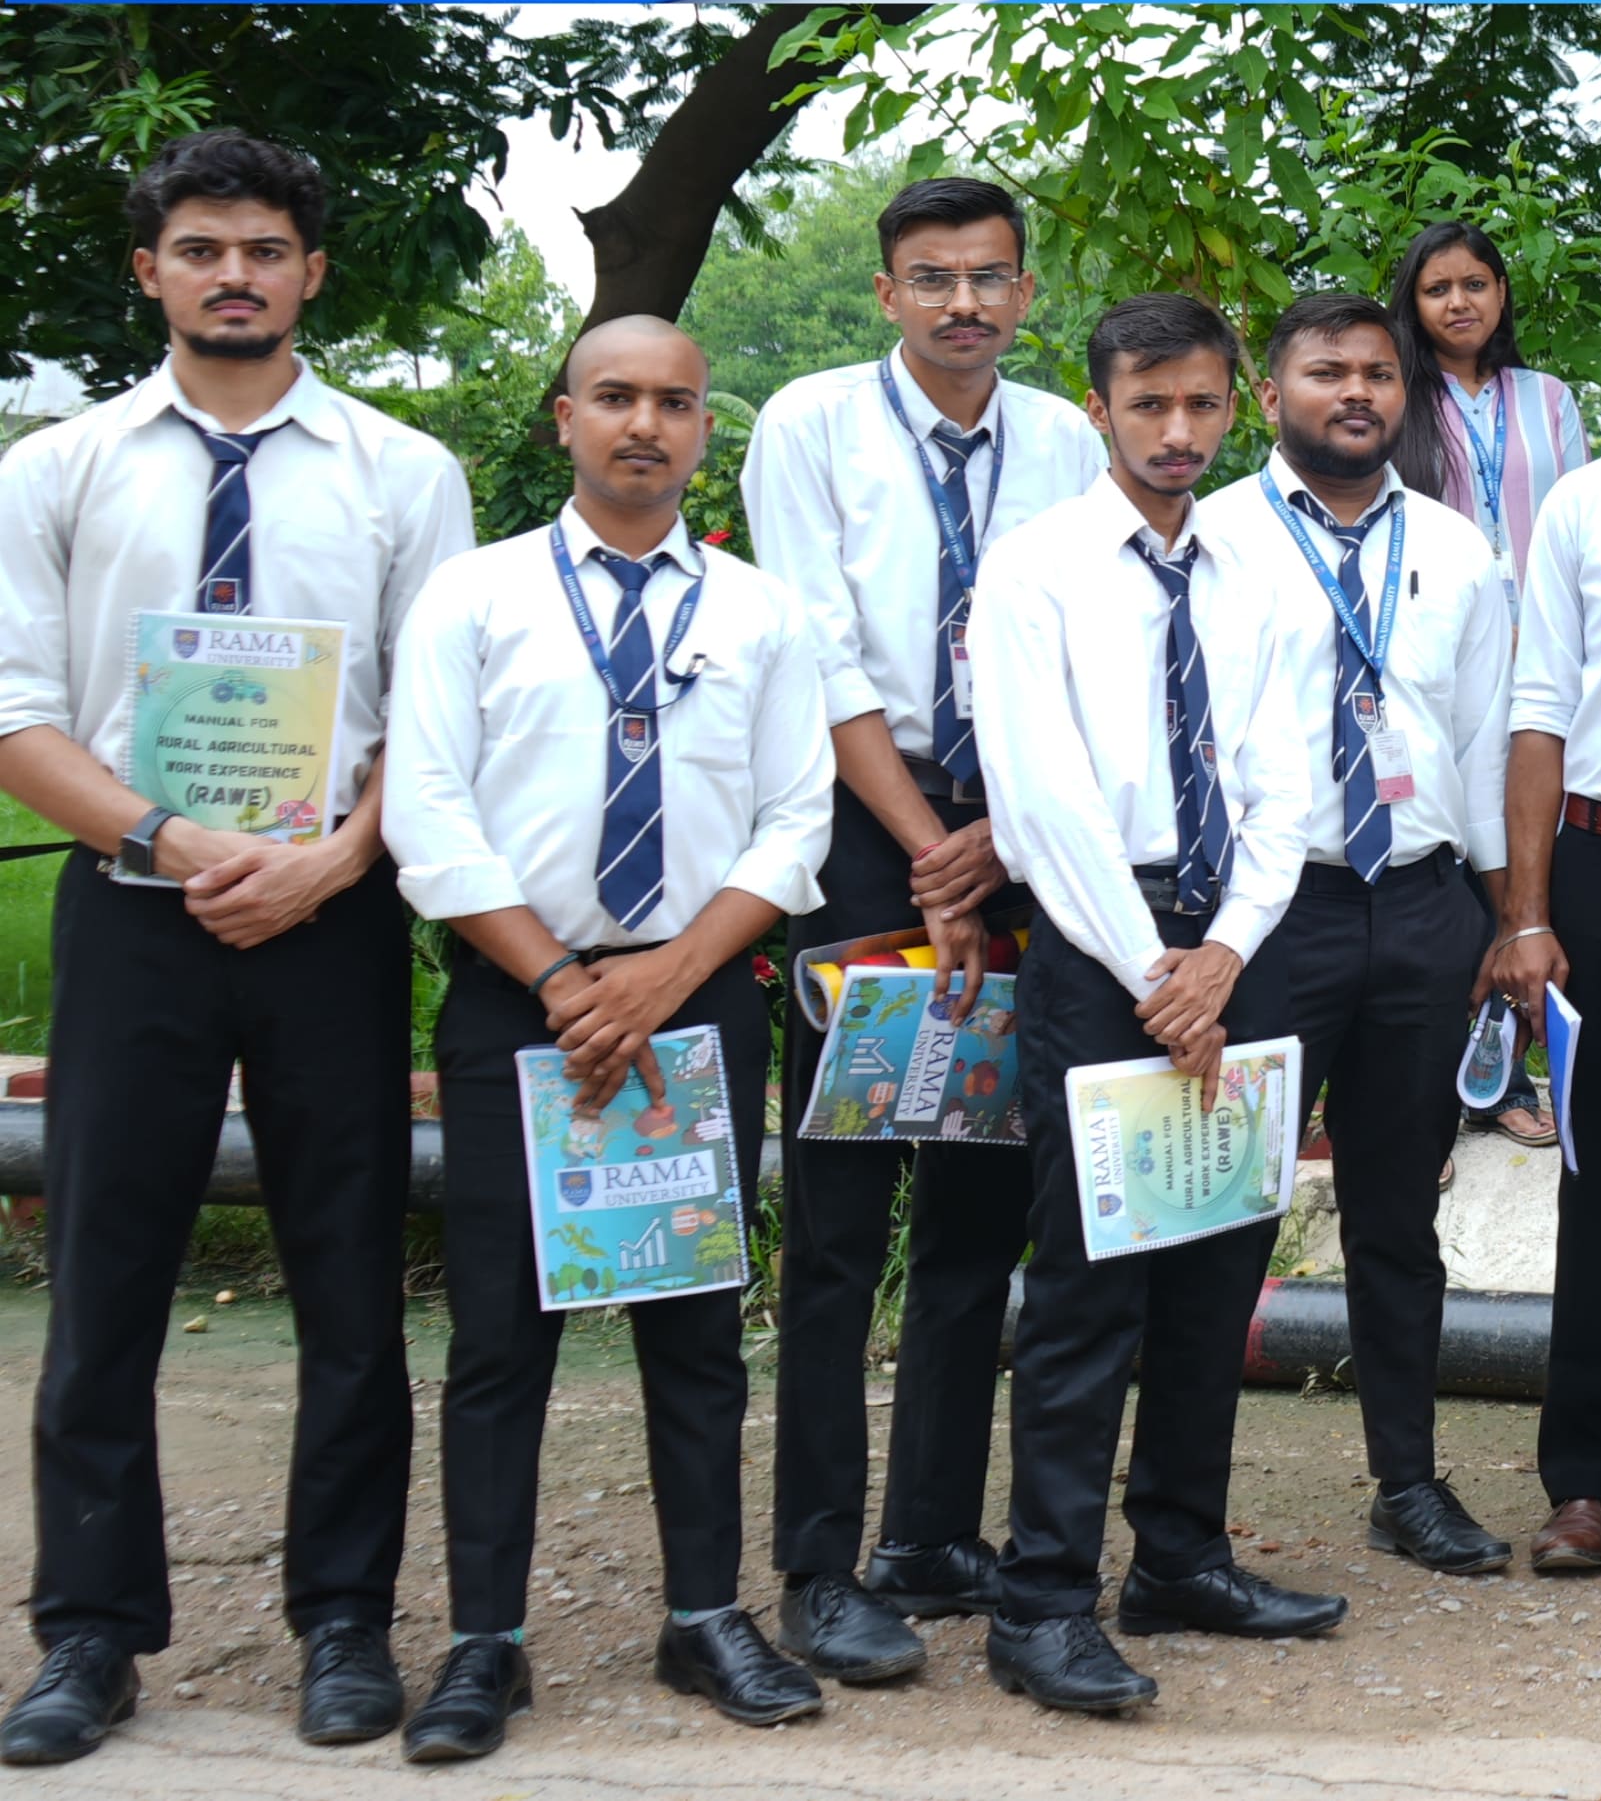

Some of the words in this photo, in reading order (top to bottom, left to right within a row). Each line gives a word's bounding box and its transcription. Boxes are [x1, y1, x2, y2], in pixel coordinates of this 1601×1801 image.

[937, 501, 957, 544] UNIVERSITY
[1272, 497, 1307, 543] UNIVERSITY
[951, 542, 964, 564] RAMA
[1300, 540, 1320, 565] RAMA
[1390, 541, 1400, 562] RAMA
[1326, 584, 1360, 635] UNIVERSITY
[1378, 583, 1396, 633] UNIVERSITY
[208, 630, 296, 654] RAMA
[1374, 633, 1386, 658] RAMA
[207, 653, 297, 668] UNIVERSITY
[184, 714, 245, 728] MANUAL
[250, 718, 279, 728] FOR
[156, 736, 200, 751] RURAL
[207, 740, 317, 756] AGRICULTURAL
[165, 760, 203, 776] WORK
[208, 764, 302, 779] EXPERIENCE
[185, 783, 273, 810] (RAWE)
[899, 1030, 930, 1116] UNIVERSITY
[914, 1031, 954, 1115] RAMA
[1163, 1115, 1172, 1140] FOR
[1180, 1078, 1195, 1167] AGRICULTURAL
[1089, 1117, 1112, 1189] RAMA
[1107, 1116, 1123, 1186] UNIVERSITY
[1215, 1106, 1233, 1174] (RAWE)
[604, 1156, 707, 1191] RAMA
[1163, 1144, 1173, 1191] MANUAL
[1202, 1168, 1211, 1197] WORK
[605, 1181, 710, 1207] UNIVERSITY
[1184, 1171, 1194, 1210] RURAL
